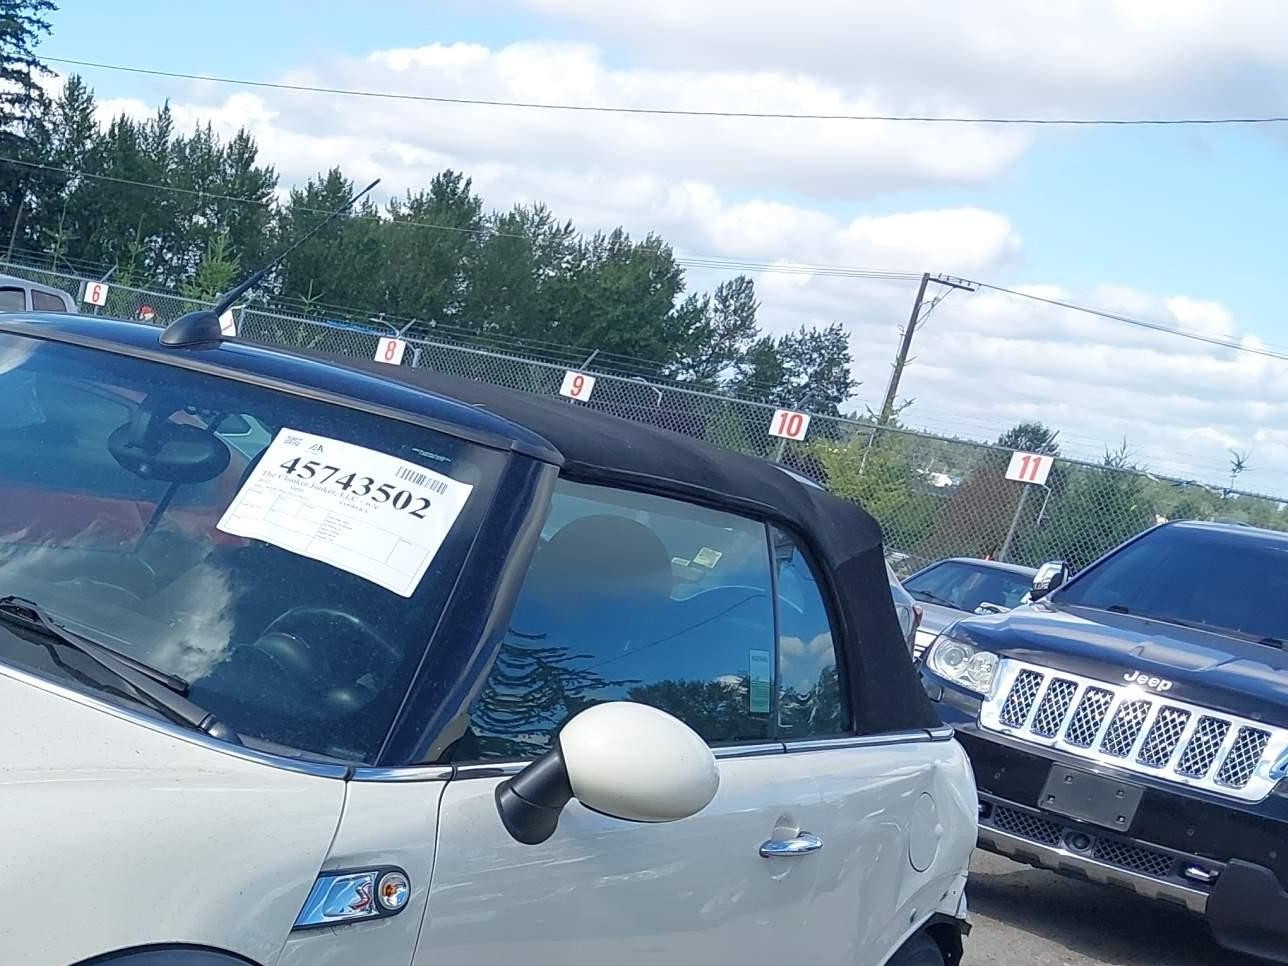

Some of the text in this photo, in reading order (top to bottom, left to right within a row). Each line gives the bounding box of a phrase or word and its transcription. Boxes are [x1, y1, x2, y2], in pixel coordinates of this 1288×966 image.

[92, 284, 102, 303] 6
[384, 340, 397, 362] 8
[570, 375, 585, 397] 9
[776, 411, 804, 438] 10
[1016, 454, 1043, 482] 11
[279, 456, 432, 520] 45743502
[1123, 670, 1173, 692] Jeep
